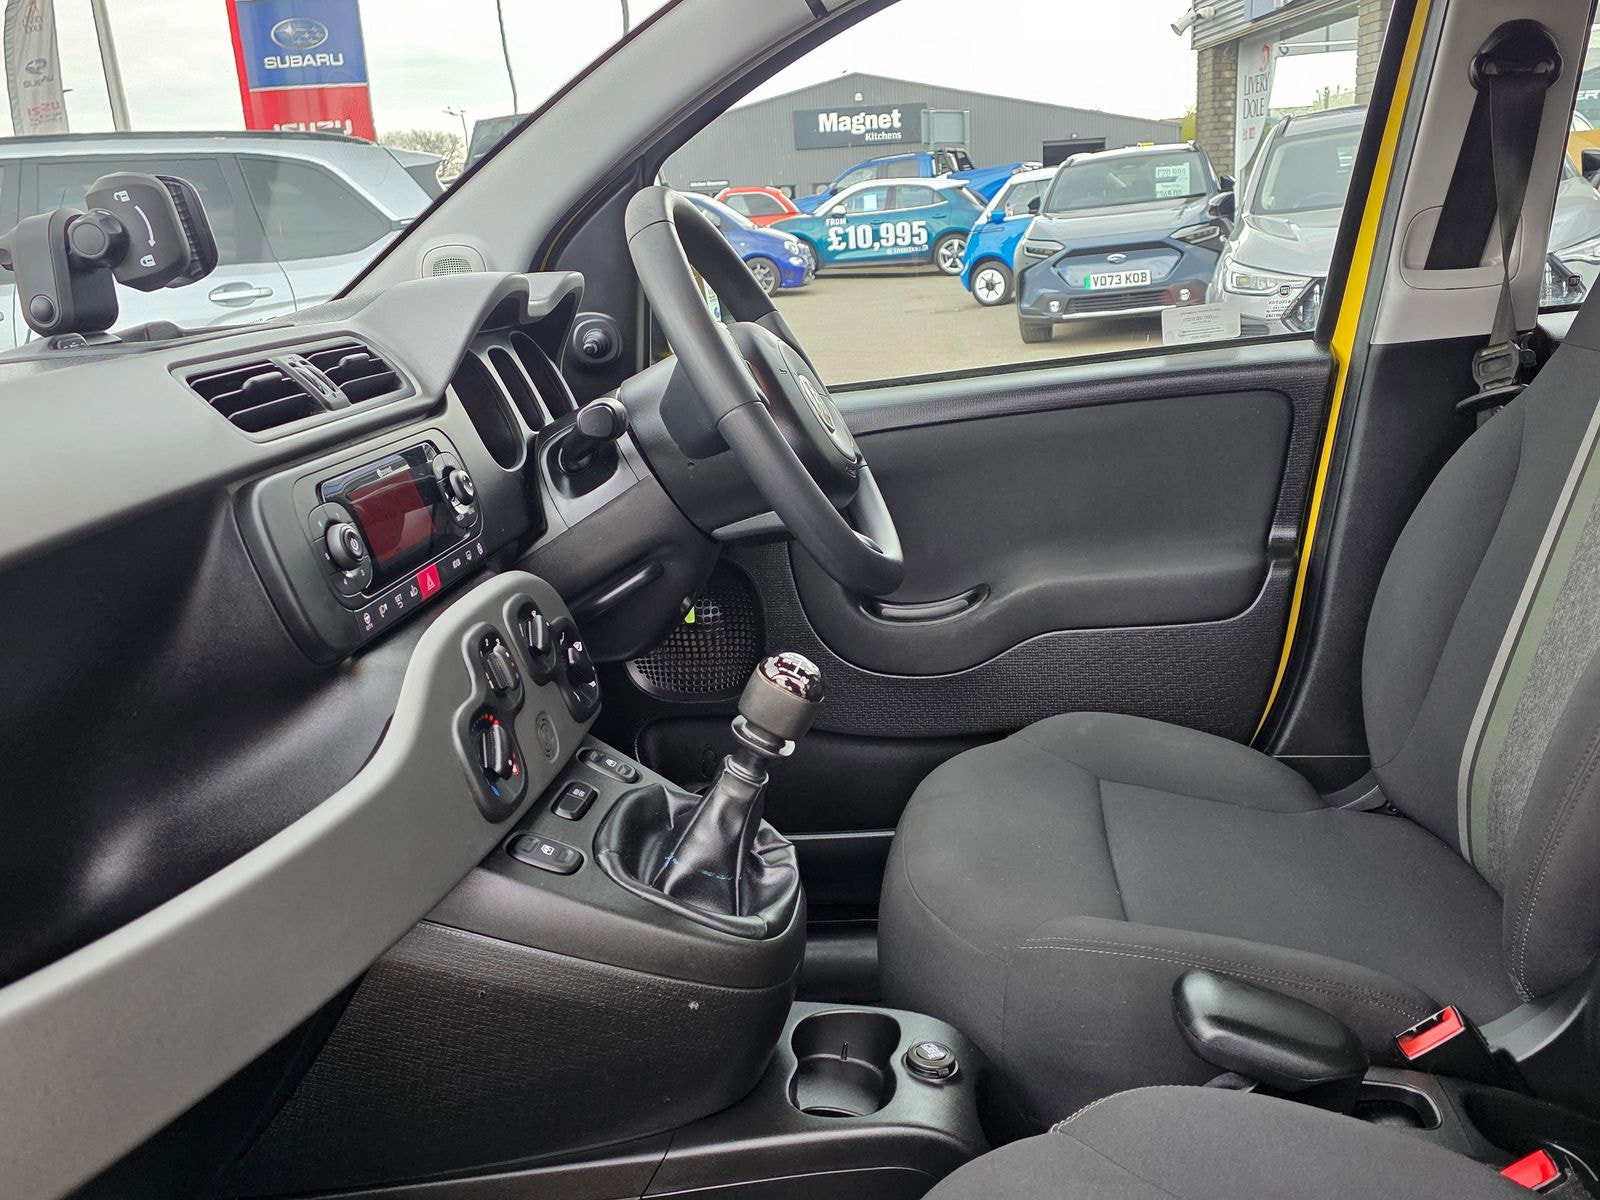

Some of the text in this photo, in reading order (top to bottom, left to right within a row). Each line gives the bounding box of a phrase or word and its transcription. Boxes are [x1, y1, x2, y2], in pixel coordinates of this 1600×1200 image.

[263, 52, 345, 70] SUBARU
[1244, 71, 1270, 96] LIVERY
[1243, 97, 1265, 120] DOLE
[818, 108, 902, 135] Magnet
[865, 131, 902, 141] Kitchens
[825, 217, 847, 226] FROM
[827, 220, 929, 252] £10,995
[1125, 271, 1148, 284] KOB
